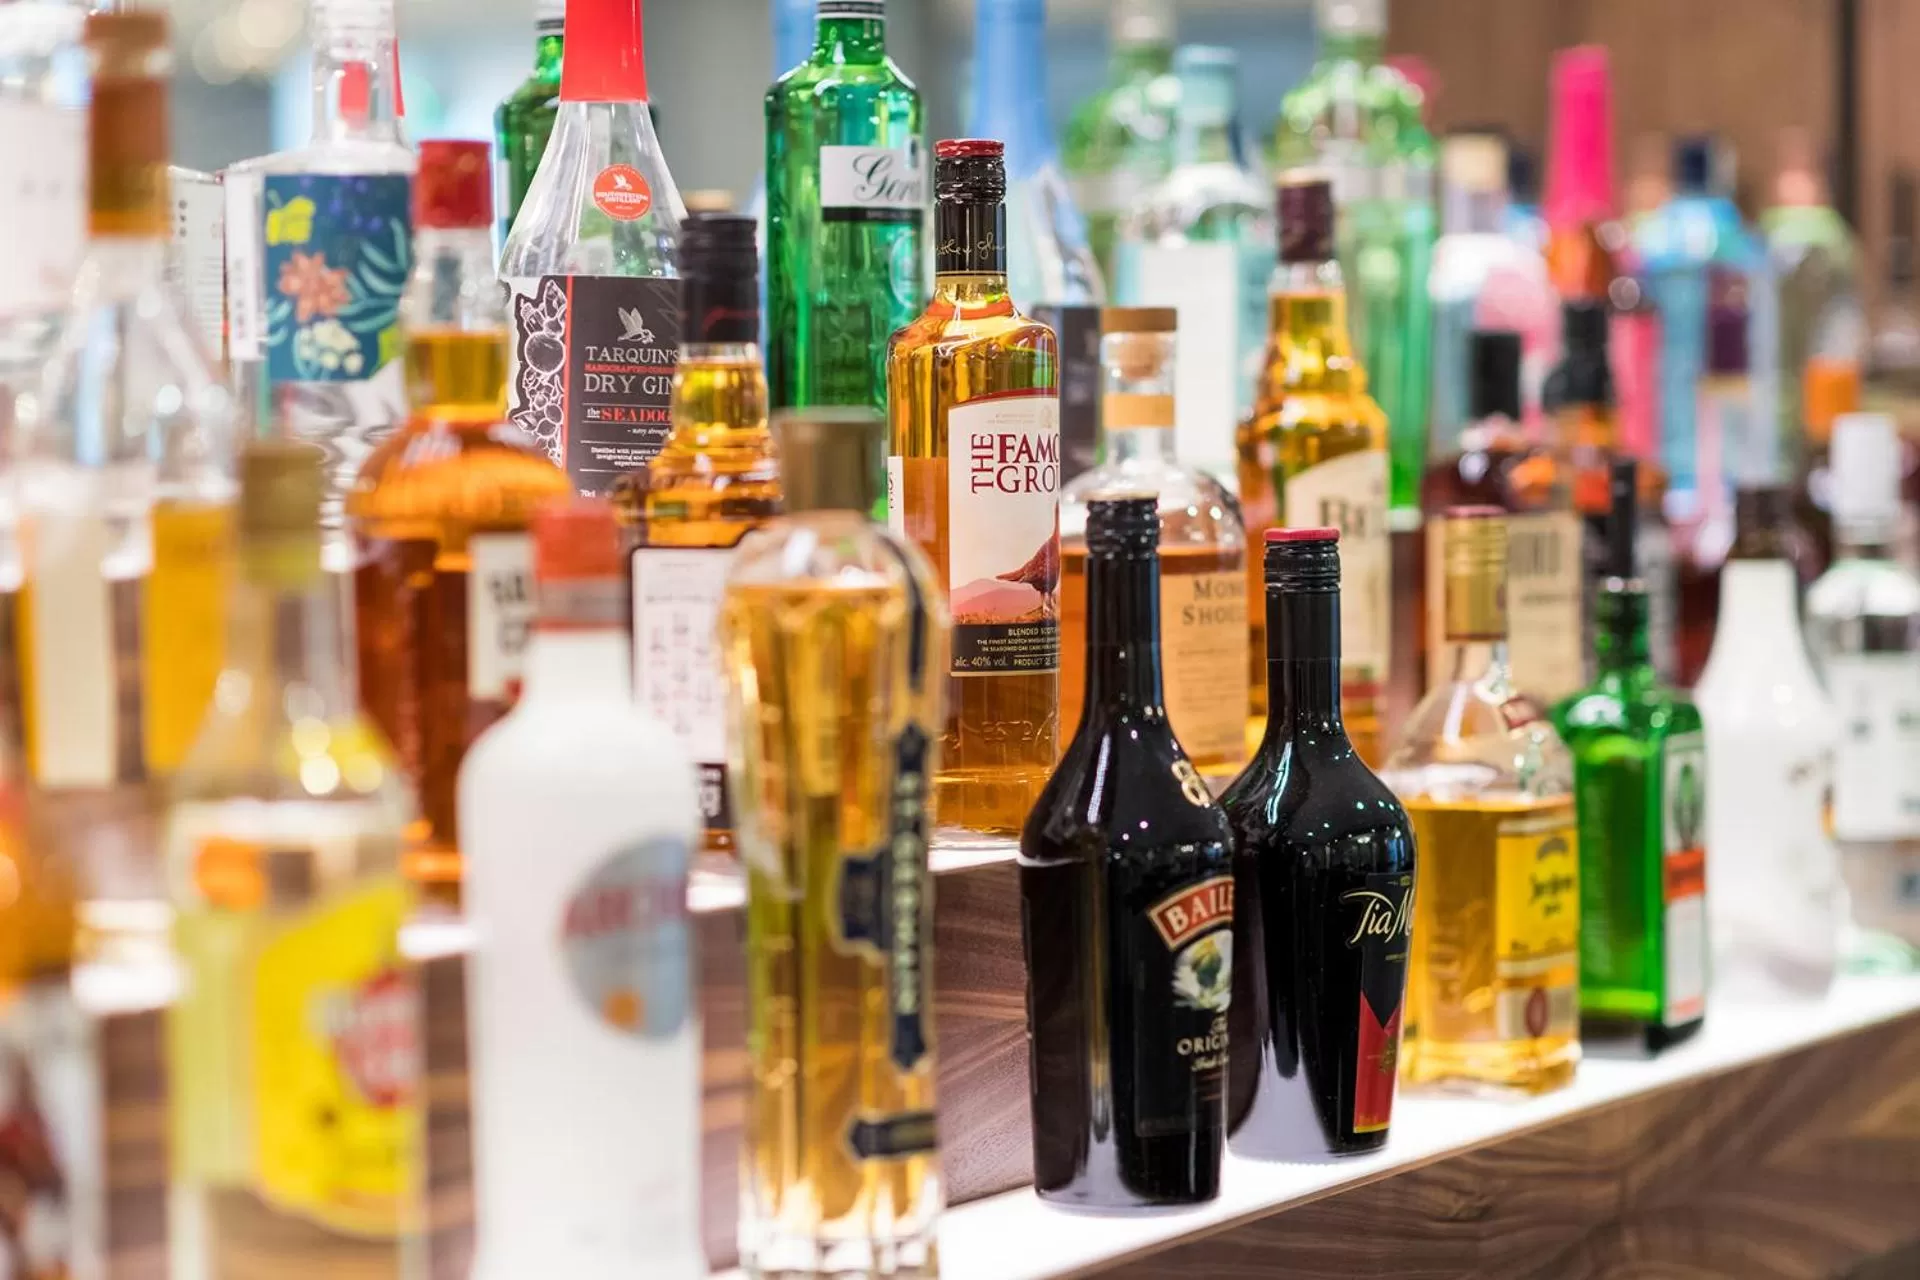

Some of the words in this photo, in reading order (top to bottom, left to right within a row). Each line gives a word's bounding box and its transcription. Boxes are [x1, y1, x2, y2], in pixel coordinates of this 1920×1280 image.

[584, 346, 680, 364] TARQUIN'S
[583, 373, 636, 393] DRY
[587, 408, 600, 418] the
[971, 433, 994, 494] THE
[1008, 627, 1039, 636] BLENDED
[971, 656, 991, 667] 40%
[1343, 890, 1396, 944] Tia
